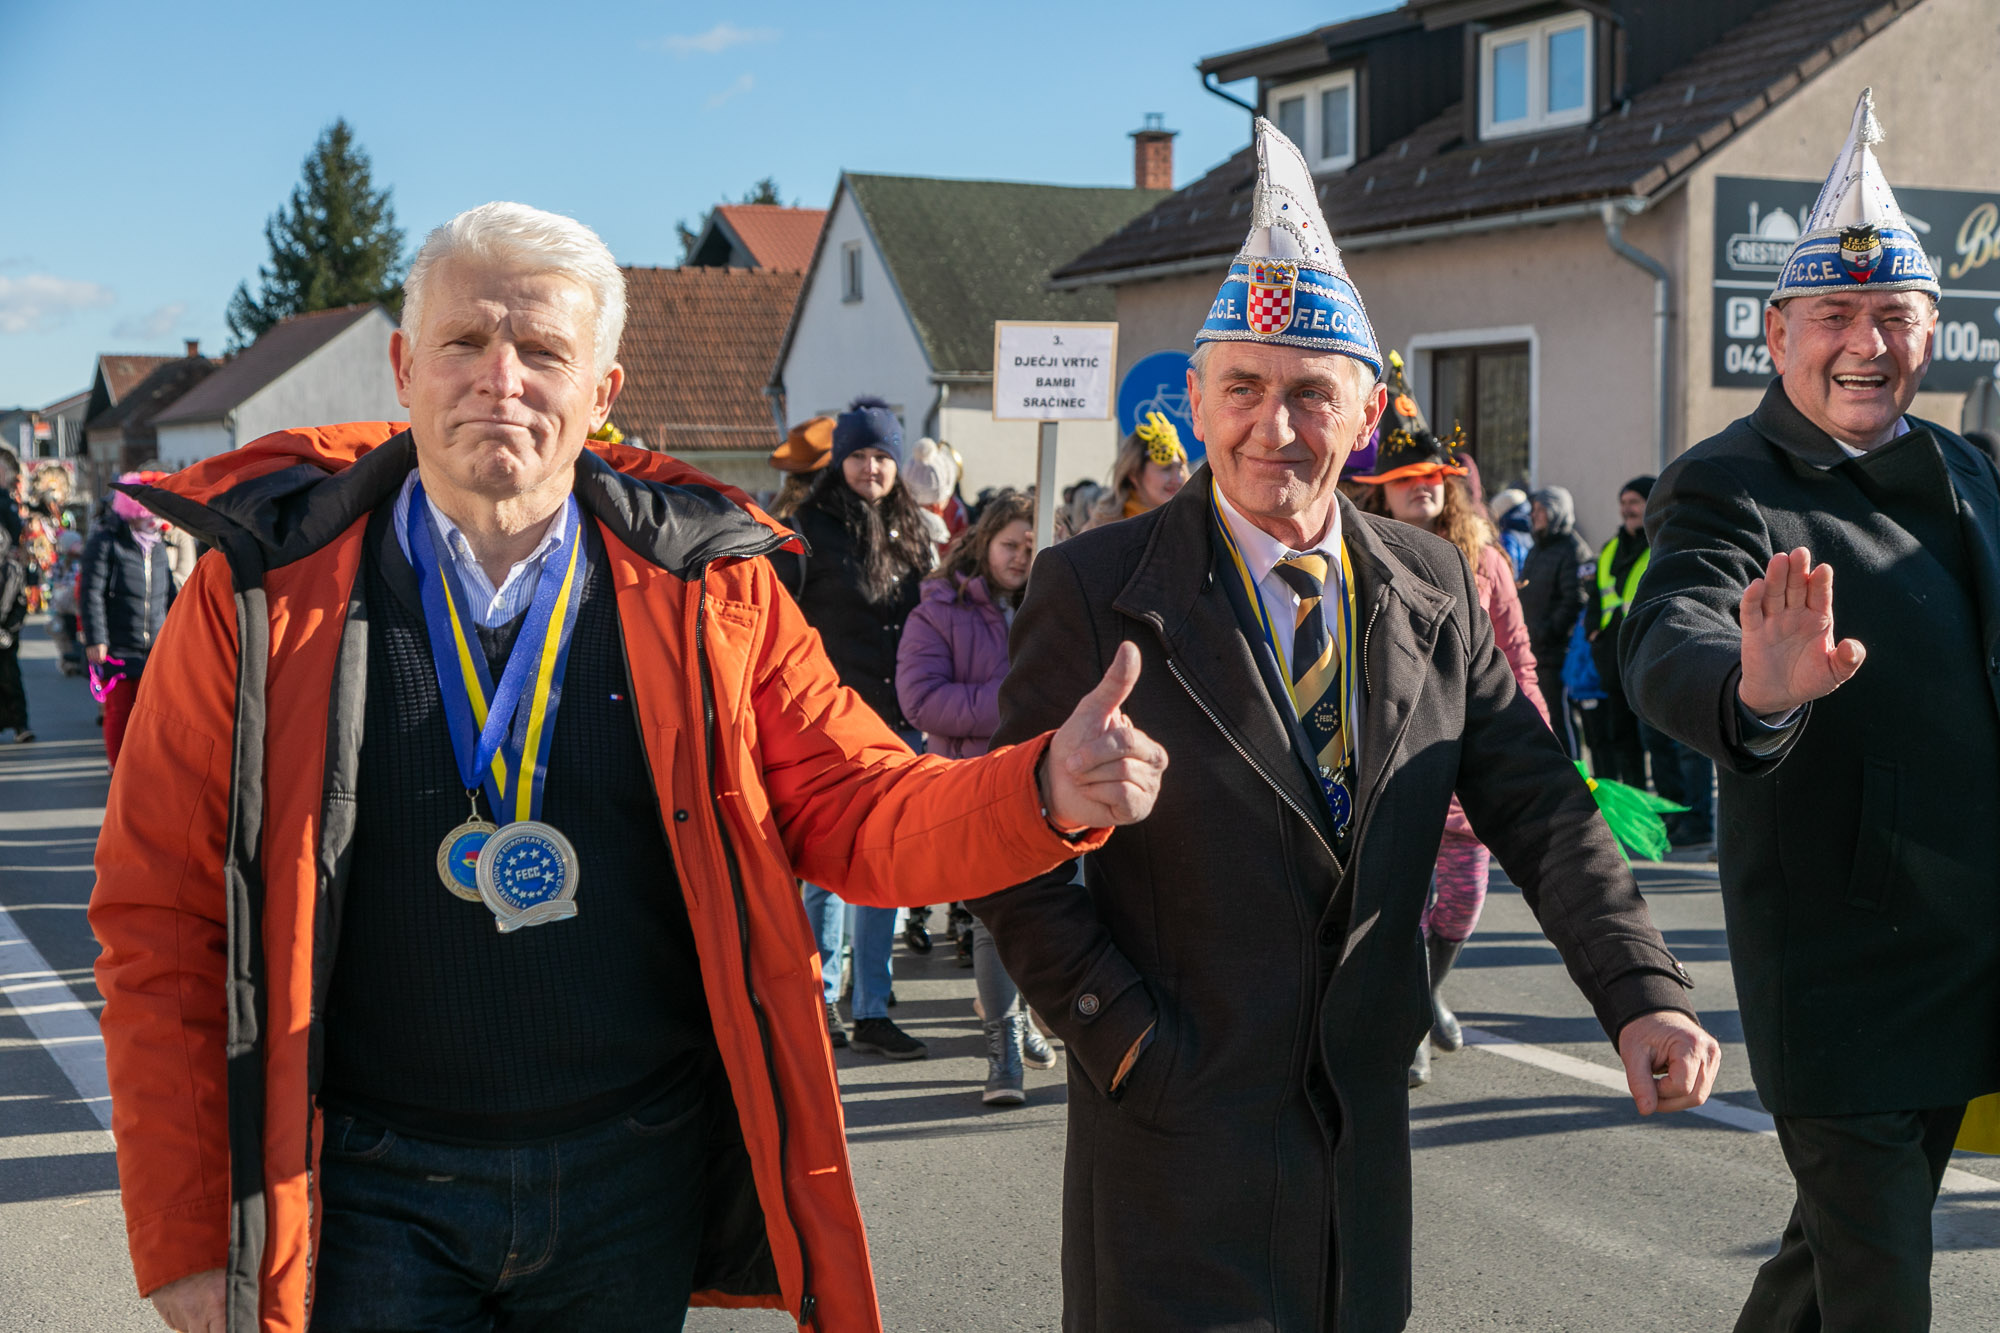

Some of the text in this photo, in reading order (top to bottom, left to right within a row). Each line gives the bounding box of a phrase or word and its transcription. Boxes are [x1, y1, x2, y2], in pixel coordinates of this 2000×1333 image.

[1052, 335, 1064, 346] 3.
[1014, 355, 1058, 367] DJEČJI
[1725, 344, 1771, 374] 042
[1035, 377, 1076, 387] BAMBI
[1023, 396, 1086, 408] SRAČINEC
[503, 836, 542, 854] EUROPEAN
[496, 853, 505, 864] OF
[542, 841, 564, 877] CARNIVAL
[515, 866, 541, 882] FECC
[493, 865, 521, 908] FEDERATION
